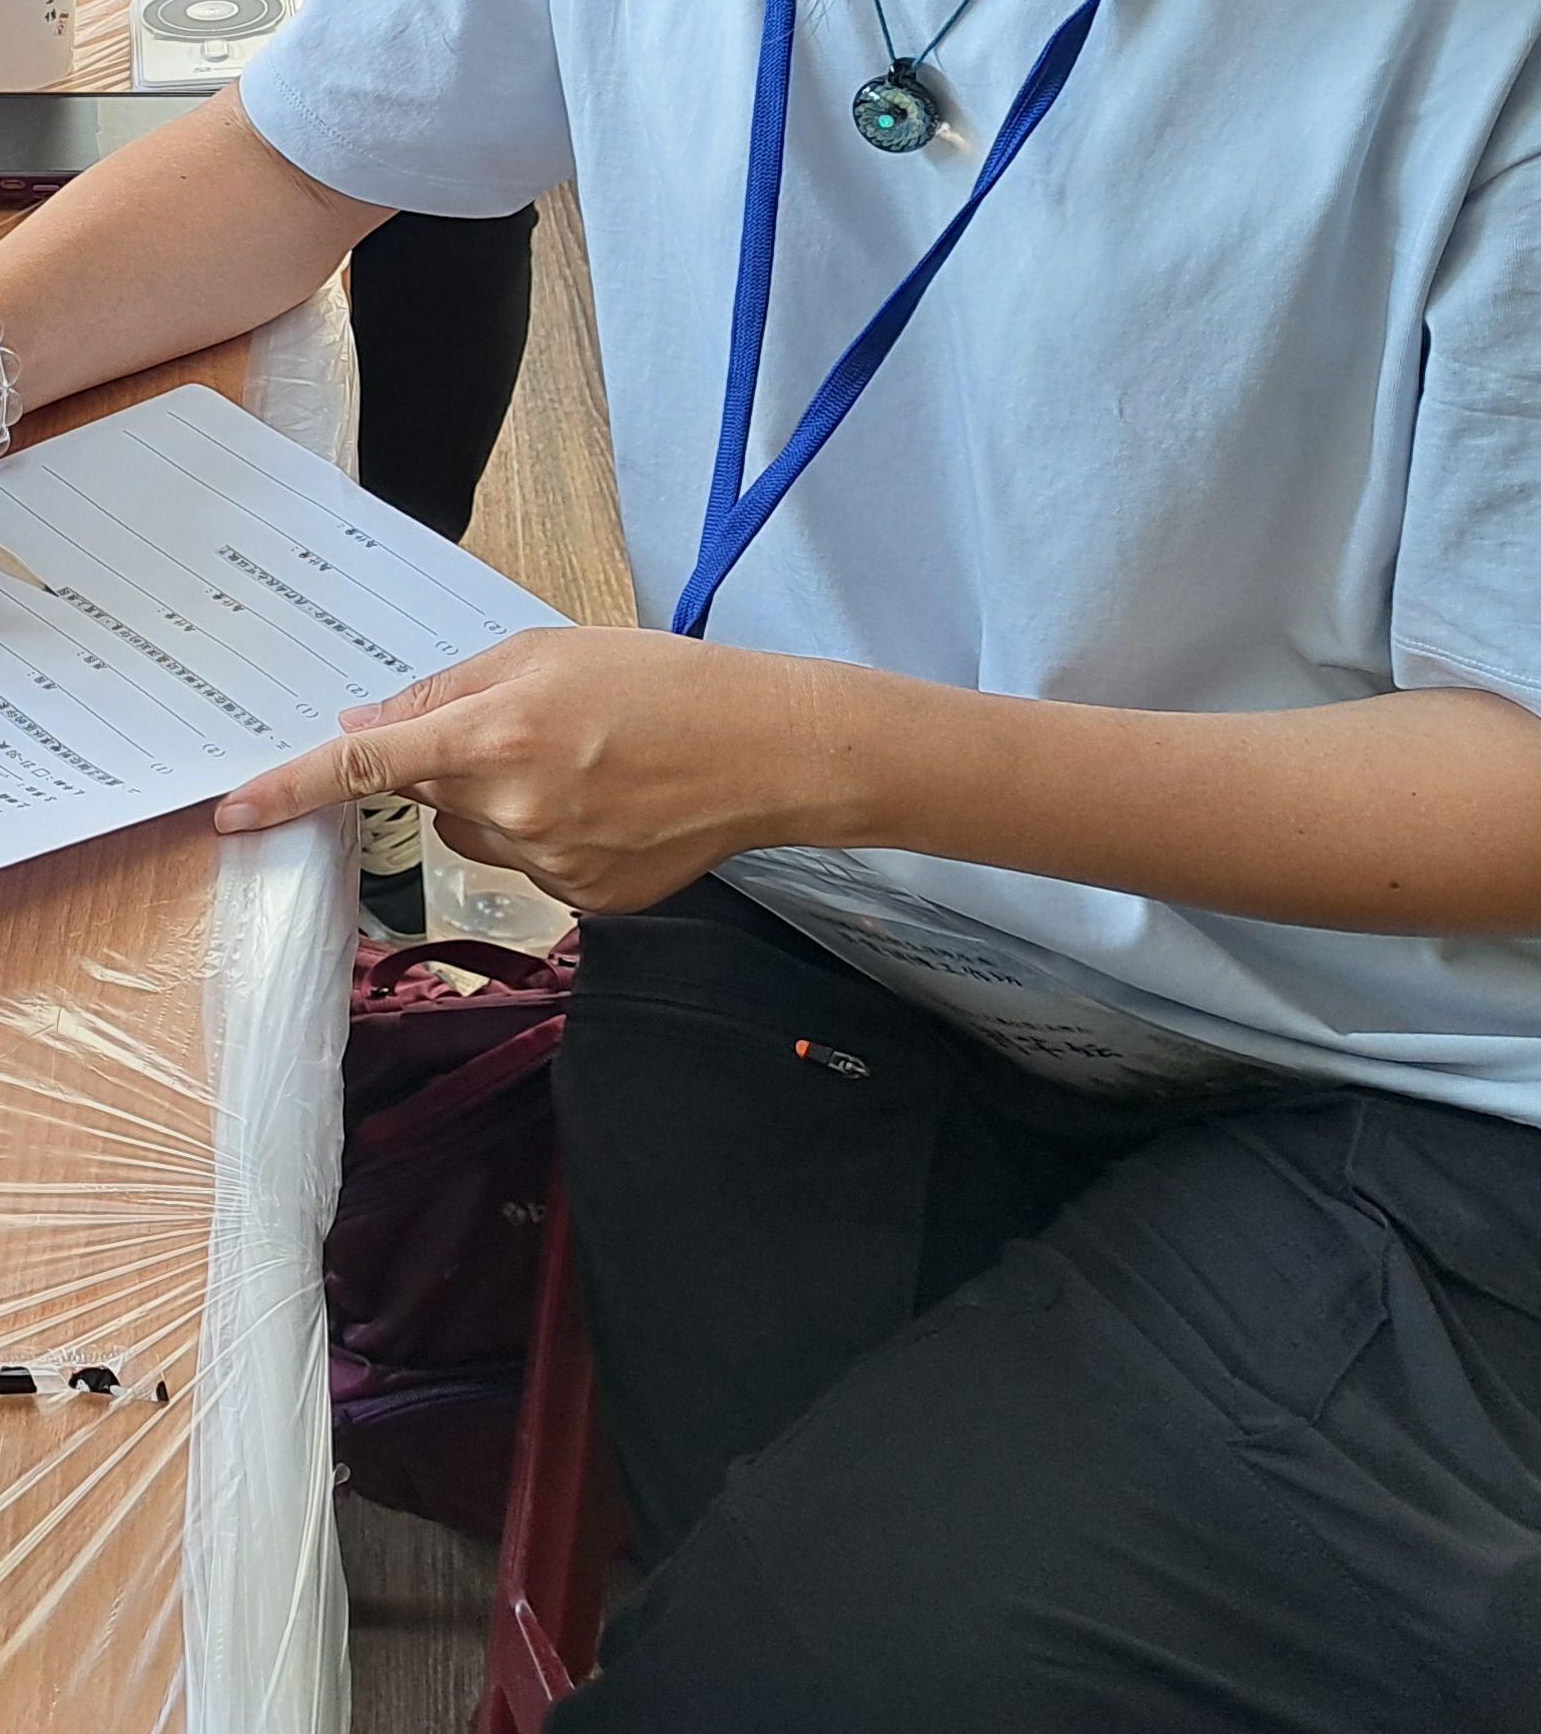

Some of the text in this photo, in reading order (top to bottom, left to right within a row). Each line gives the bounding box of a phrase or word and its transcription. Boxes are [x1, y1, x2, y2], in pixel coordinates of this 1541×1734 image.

[484, 621, 507, 634] (2)
[435, 641, 459, 655] (1)
[346, 684, 369, 697] (2)
[296, 704, 318, 718] (1)
